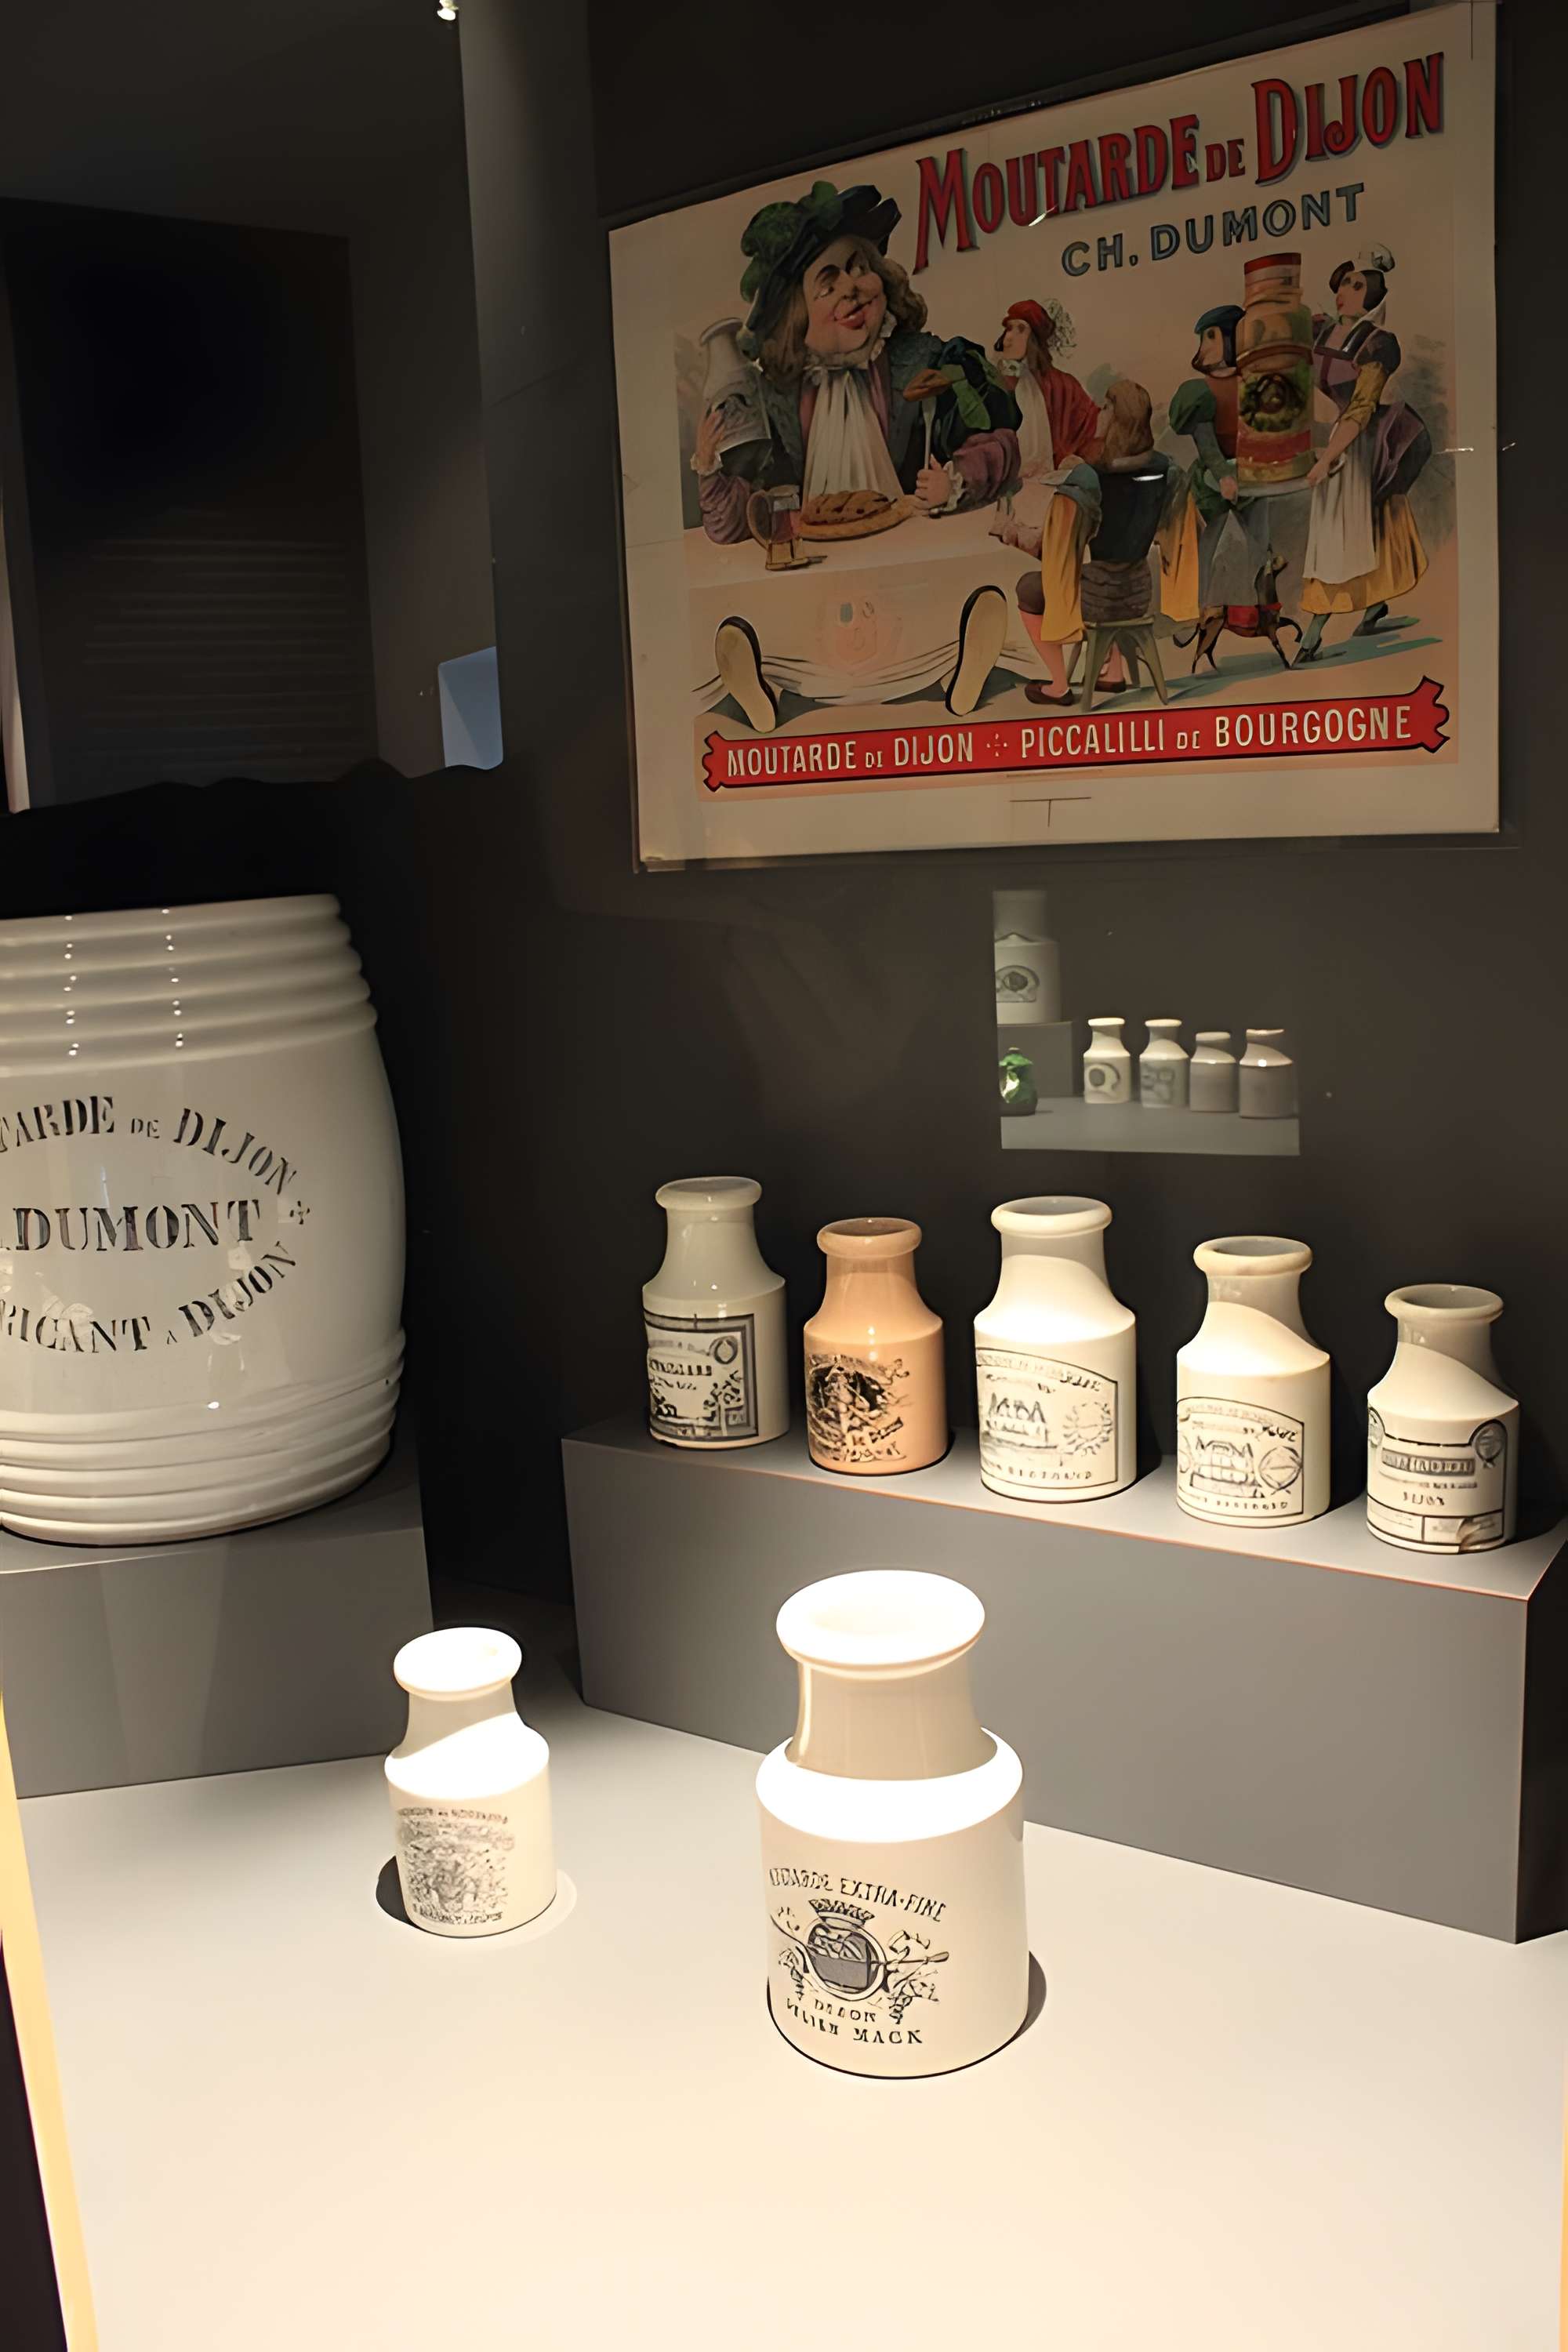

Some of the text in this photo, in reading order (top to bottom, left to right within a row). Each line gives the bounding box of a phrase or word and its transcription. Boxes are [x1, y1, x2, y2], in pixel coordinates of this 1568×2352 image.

[912, 51, 1445, 276] MOUTARDE DE DIJON
[1061, 182, 1366, 277] CH. DUMONT
[727, 740, 857, 778] MOUTARDE
[894, 731, 973, 767] DIJON
[1021, 718, 1165, 759] PICCALILLI
[1215, 705, 1412, 748] BOURGOGNE
[130, 1117, 160, 1139] DE
[172, 1107, 297, 1196] DIJON
[178, 1240, 296, 1338] DIJON
